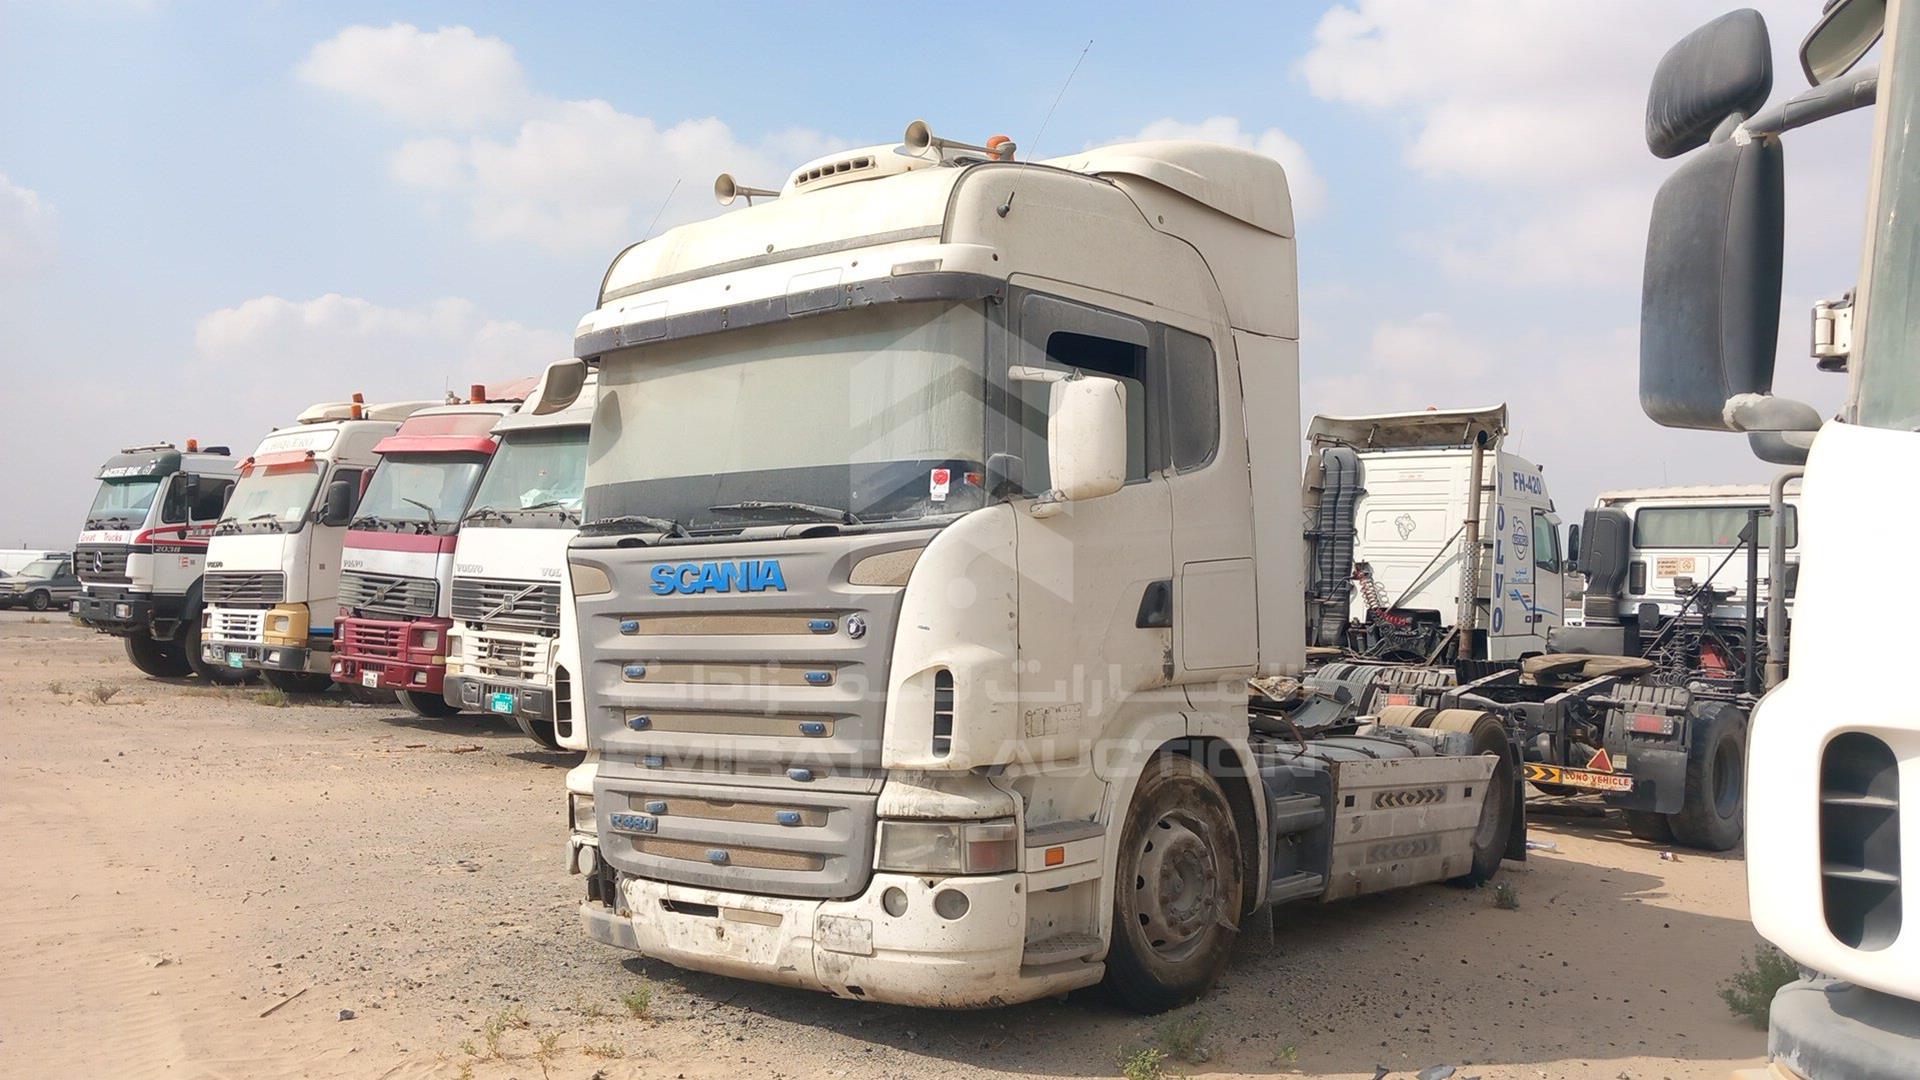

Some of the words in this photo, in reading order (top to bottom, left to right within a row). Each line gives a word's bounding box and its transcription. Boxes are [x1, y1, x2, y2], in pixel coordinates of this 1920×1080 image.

[1512, 471, 1542, 495] FH-420
[104, 532, 122, 541] Trucks
[456, 563, 484, 573] VOLVO
[541, 567, 562, 577] VOL
[650, 559, 787, 595] SCANIA
[1564, 772, 1588, 782] LONG
[1592, 775, 1630, 786] VEHICLE
